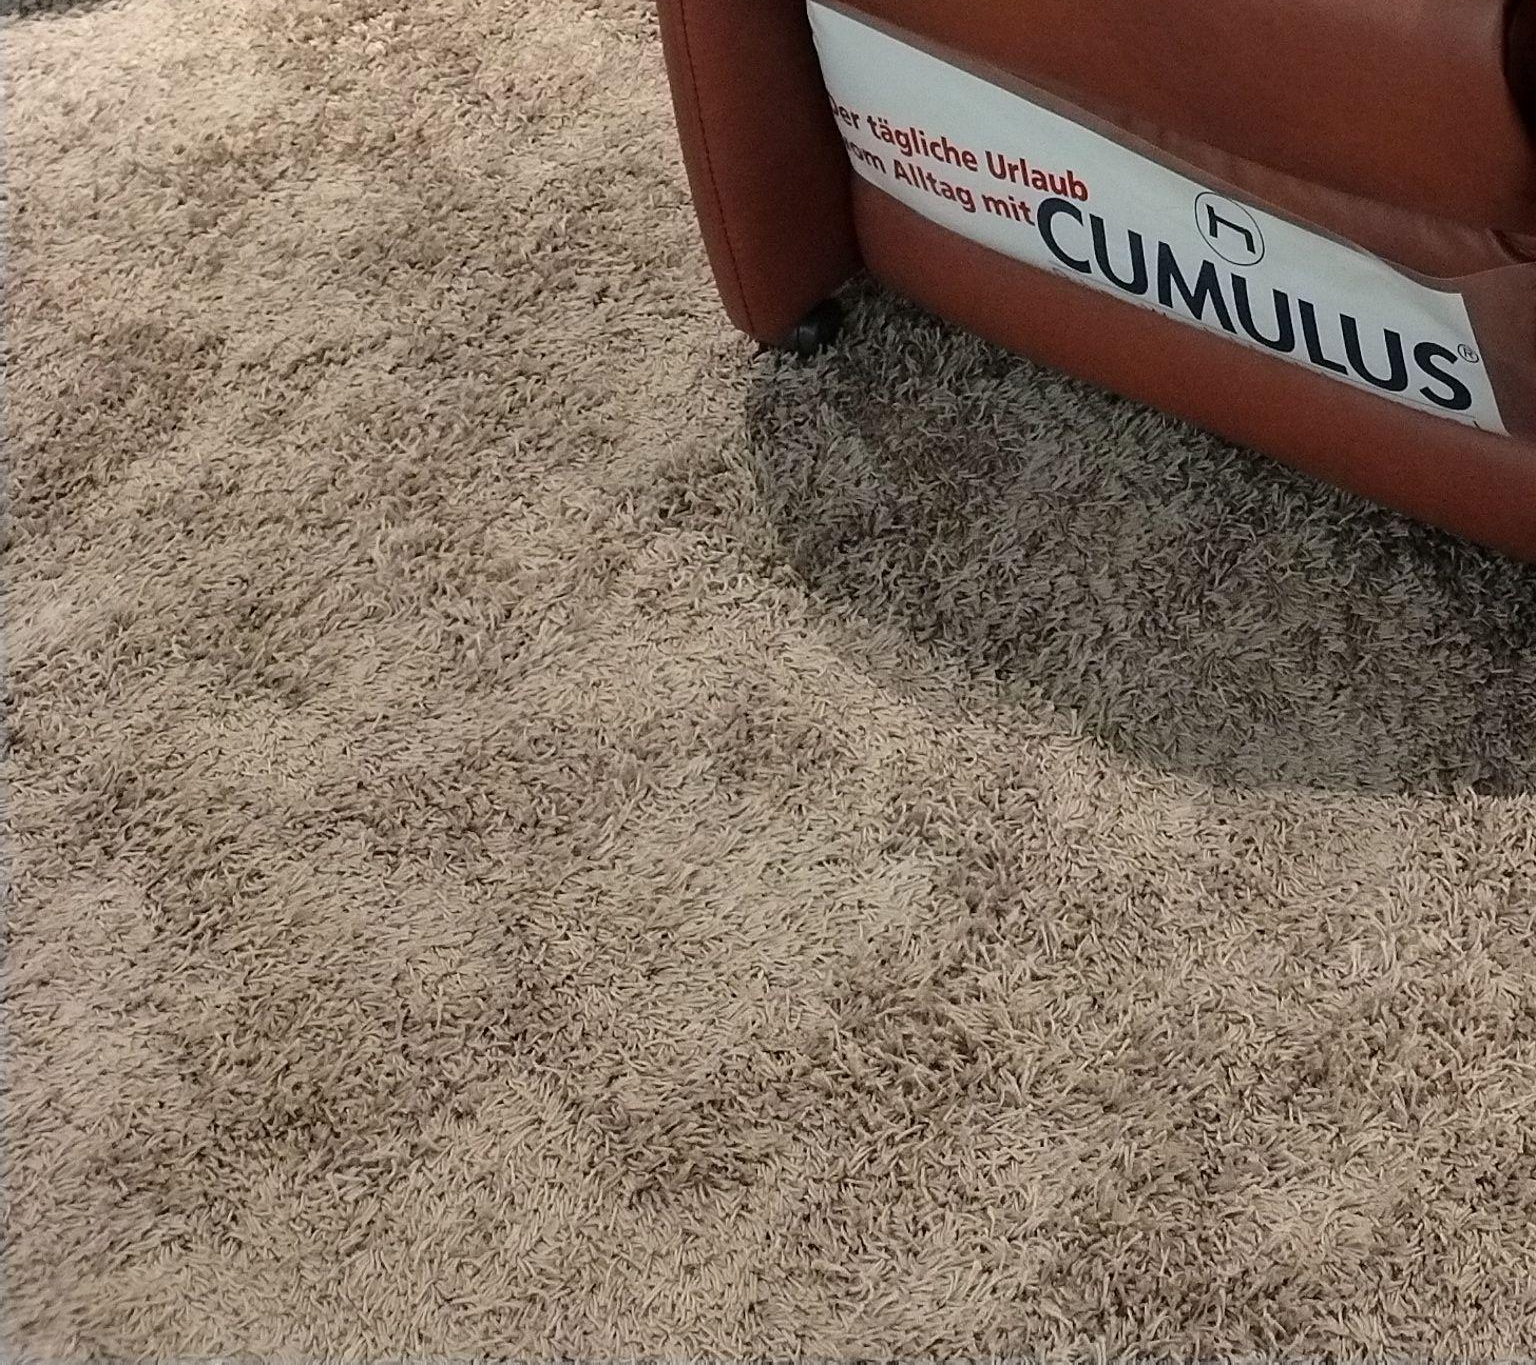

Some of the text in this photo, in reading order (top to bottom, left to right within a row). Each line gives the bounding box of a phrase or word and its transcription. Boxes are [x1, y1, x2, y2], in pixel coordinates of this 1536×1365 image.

[867, 115, 978, 172] tägliche
[985, 150, 1089, 202] Urlaub
[893, 159, 977, 213] Alltag
[981, 193, 1036, 227] mit
